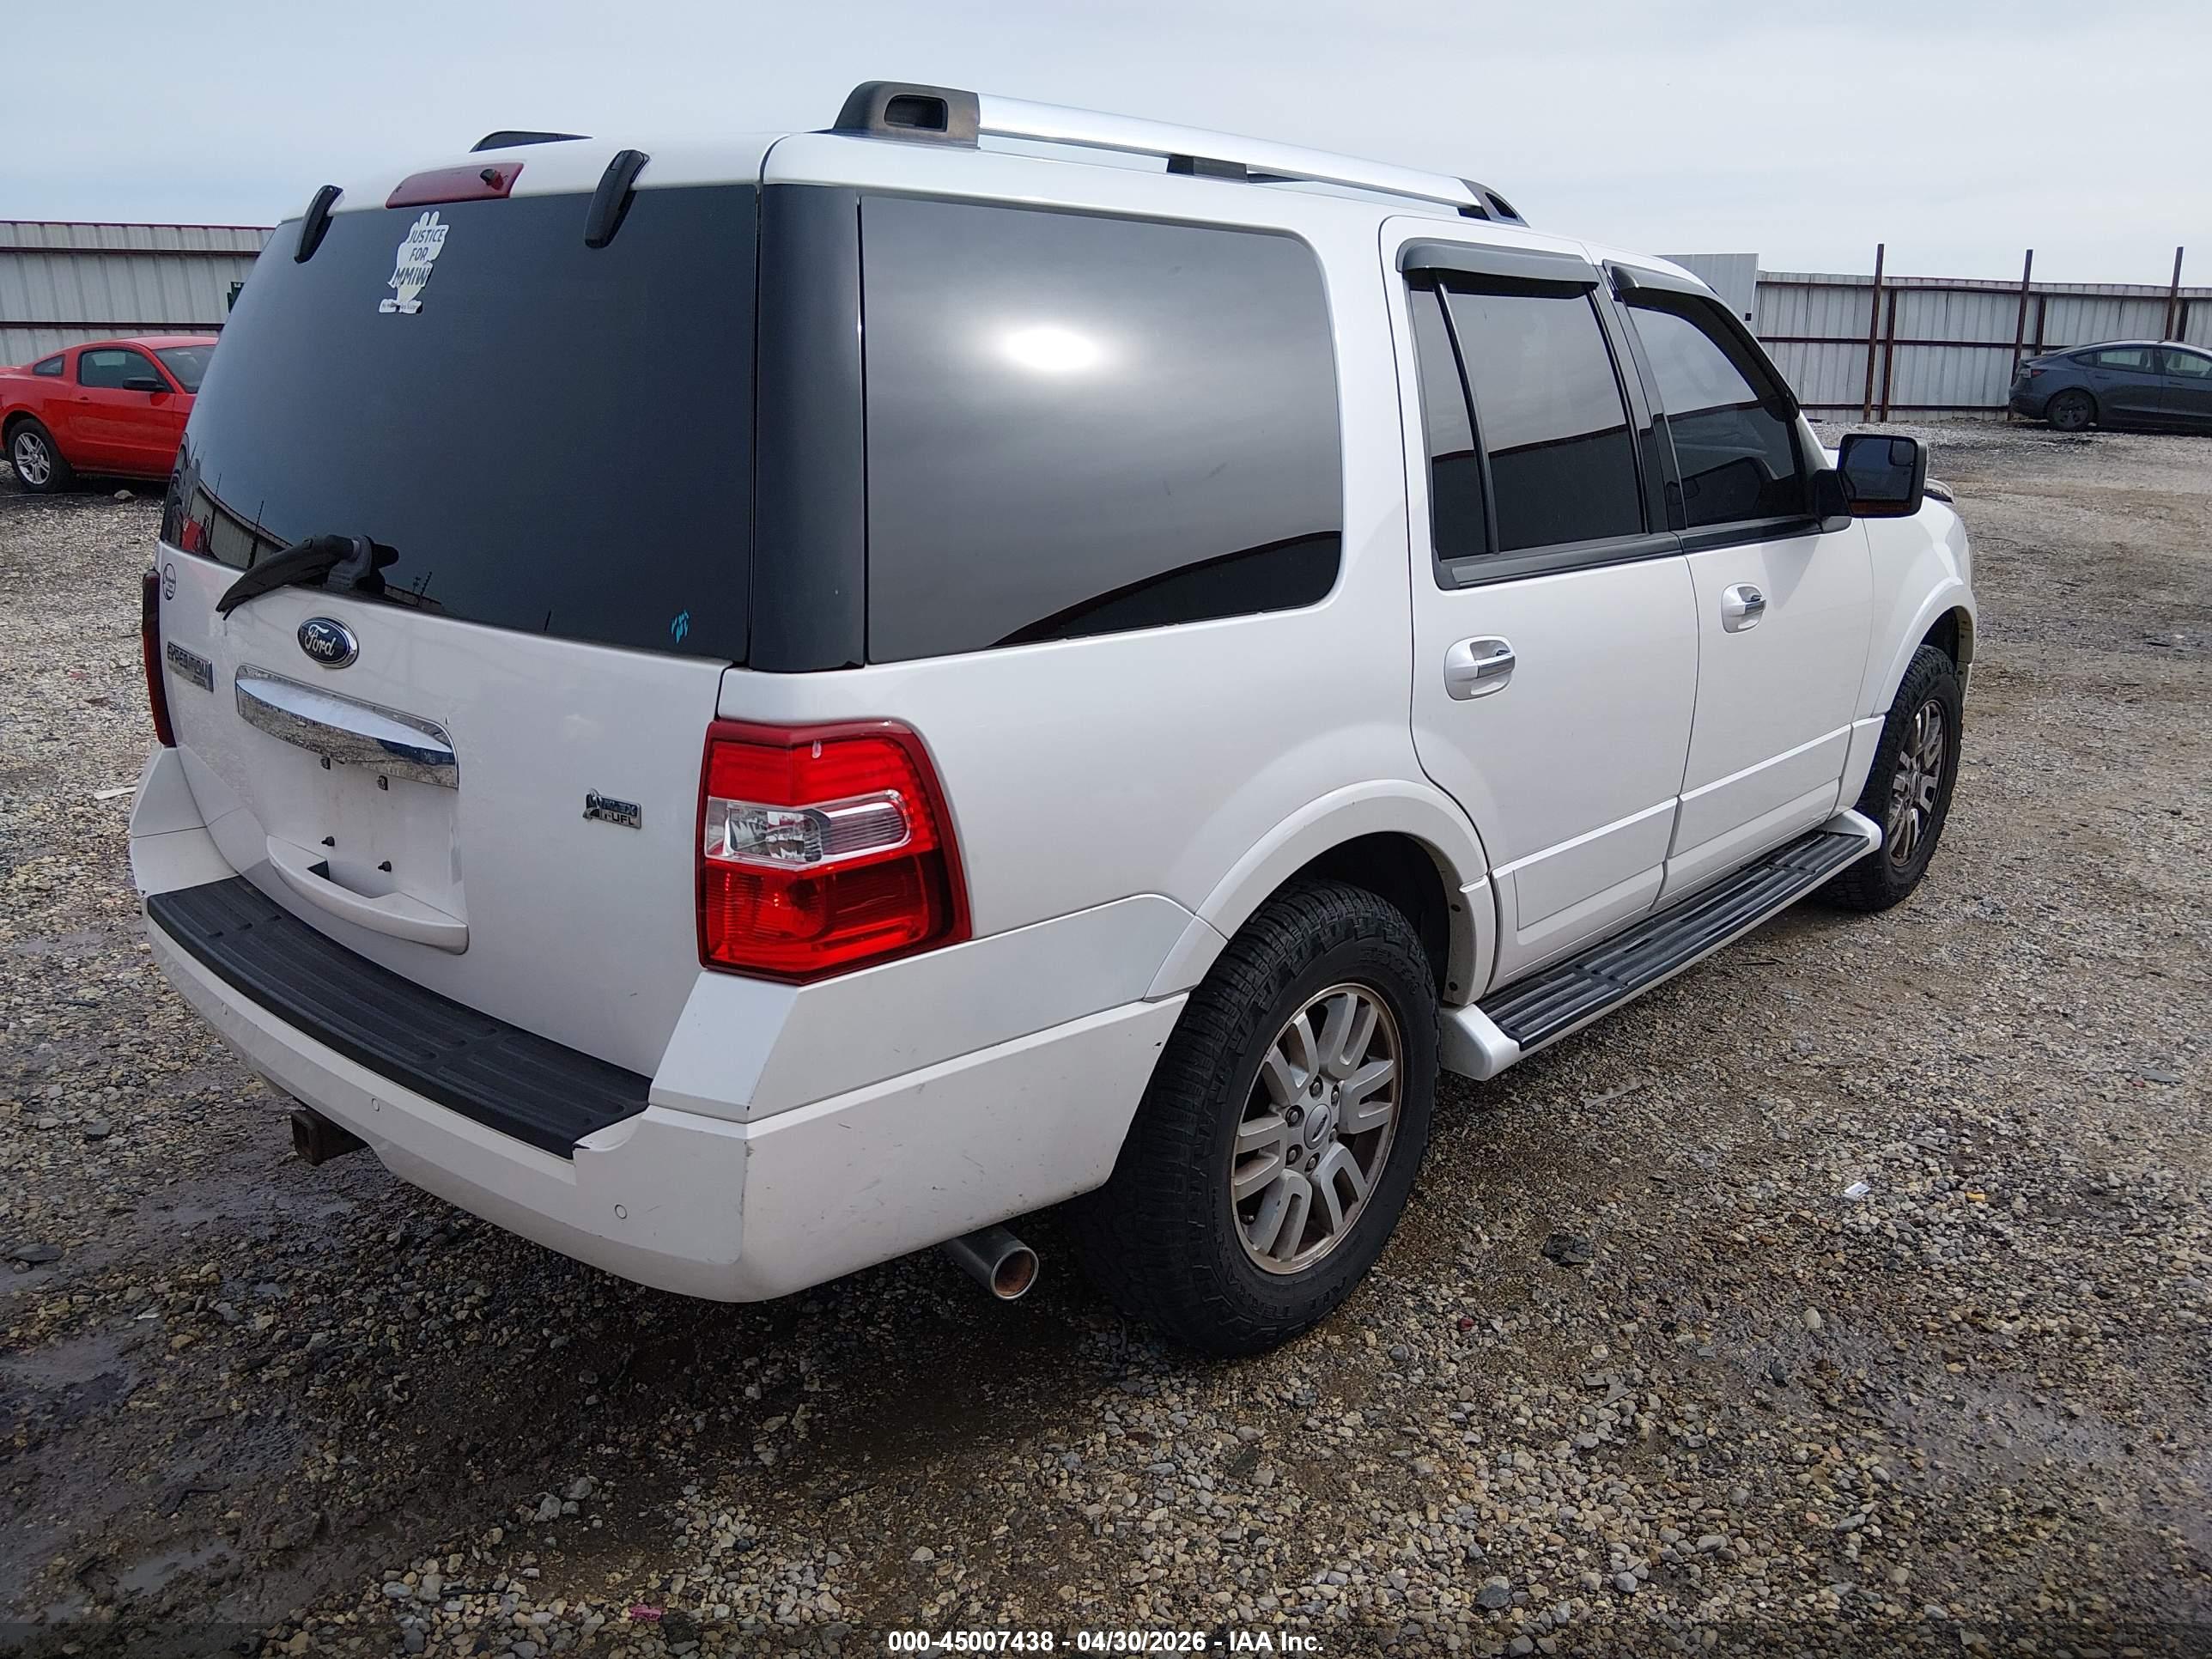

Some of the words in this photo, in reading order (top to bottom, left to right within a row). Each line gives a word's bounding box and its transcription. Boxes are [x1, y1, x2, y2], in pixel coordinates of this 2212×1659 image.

[408, 228, 446, 243] JUSTICE
[409, 247, 428, 261] FOR
[392, 267, 430, 286] MMIW
[305, 623, 337, 657] Ford
